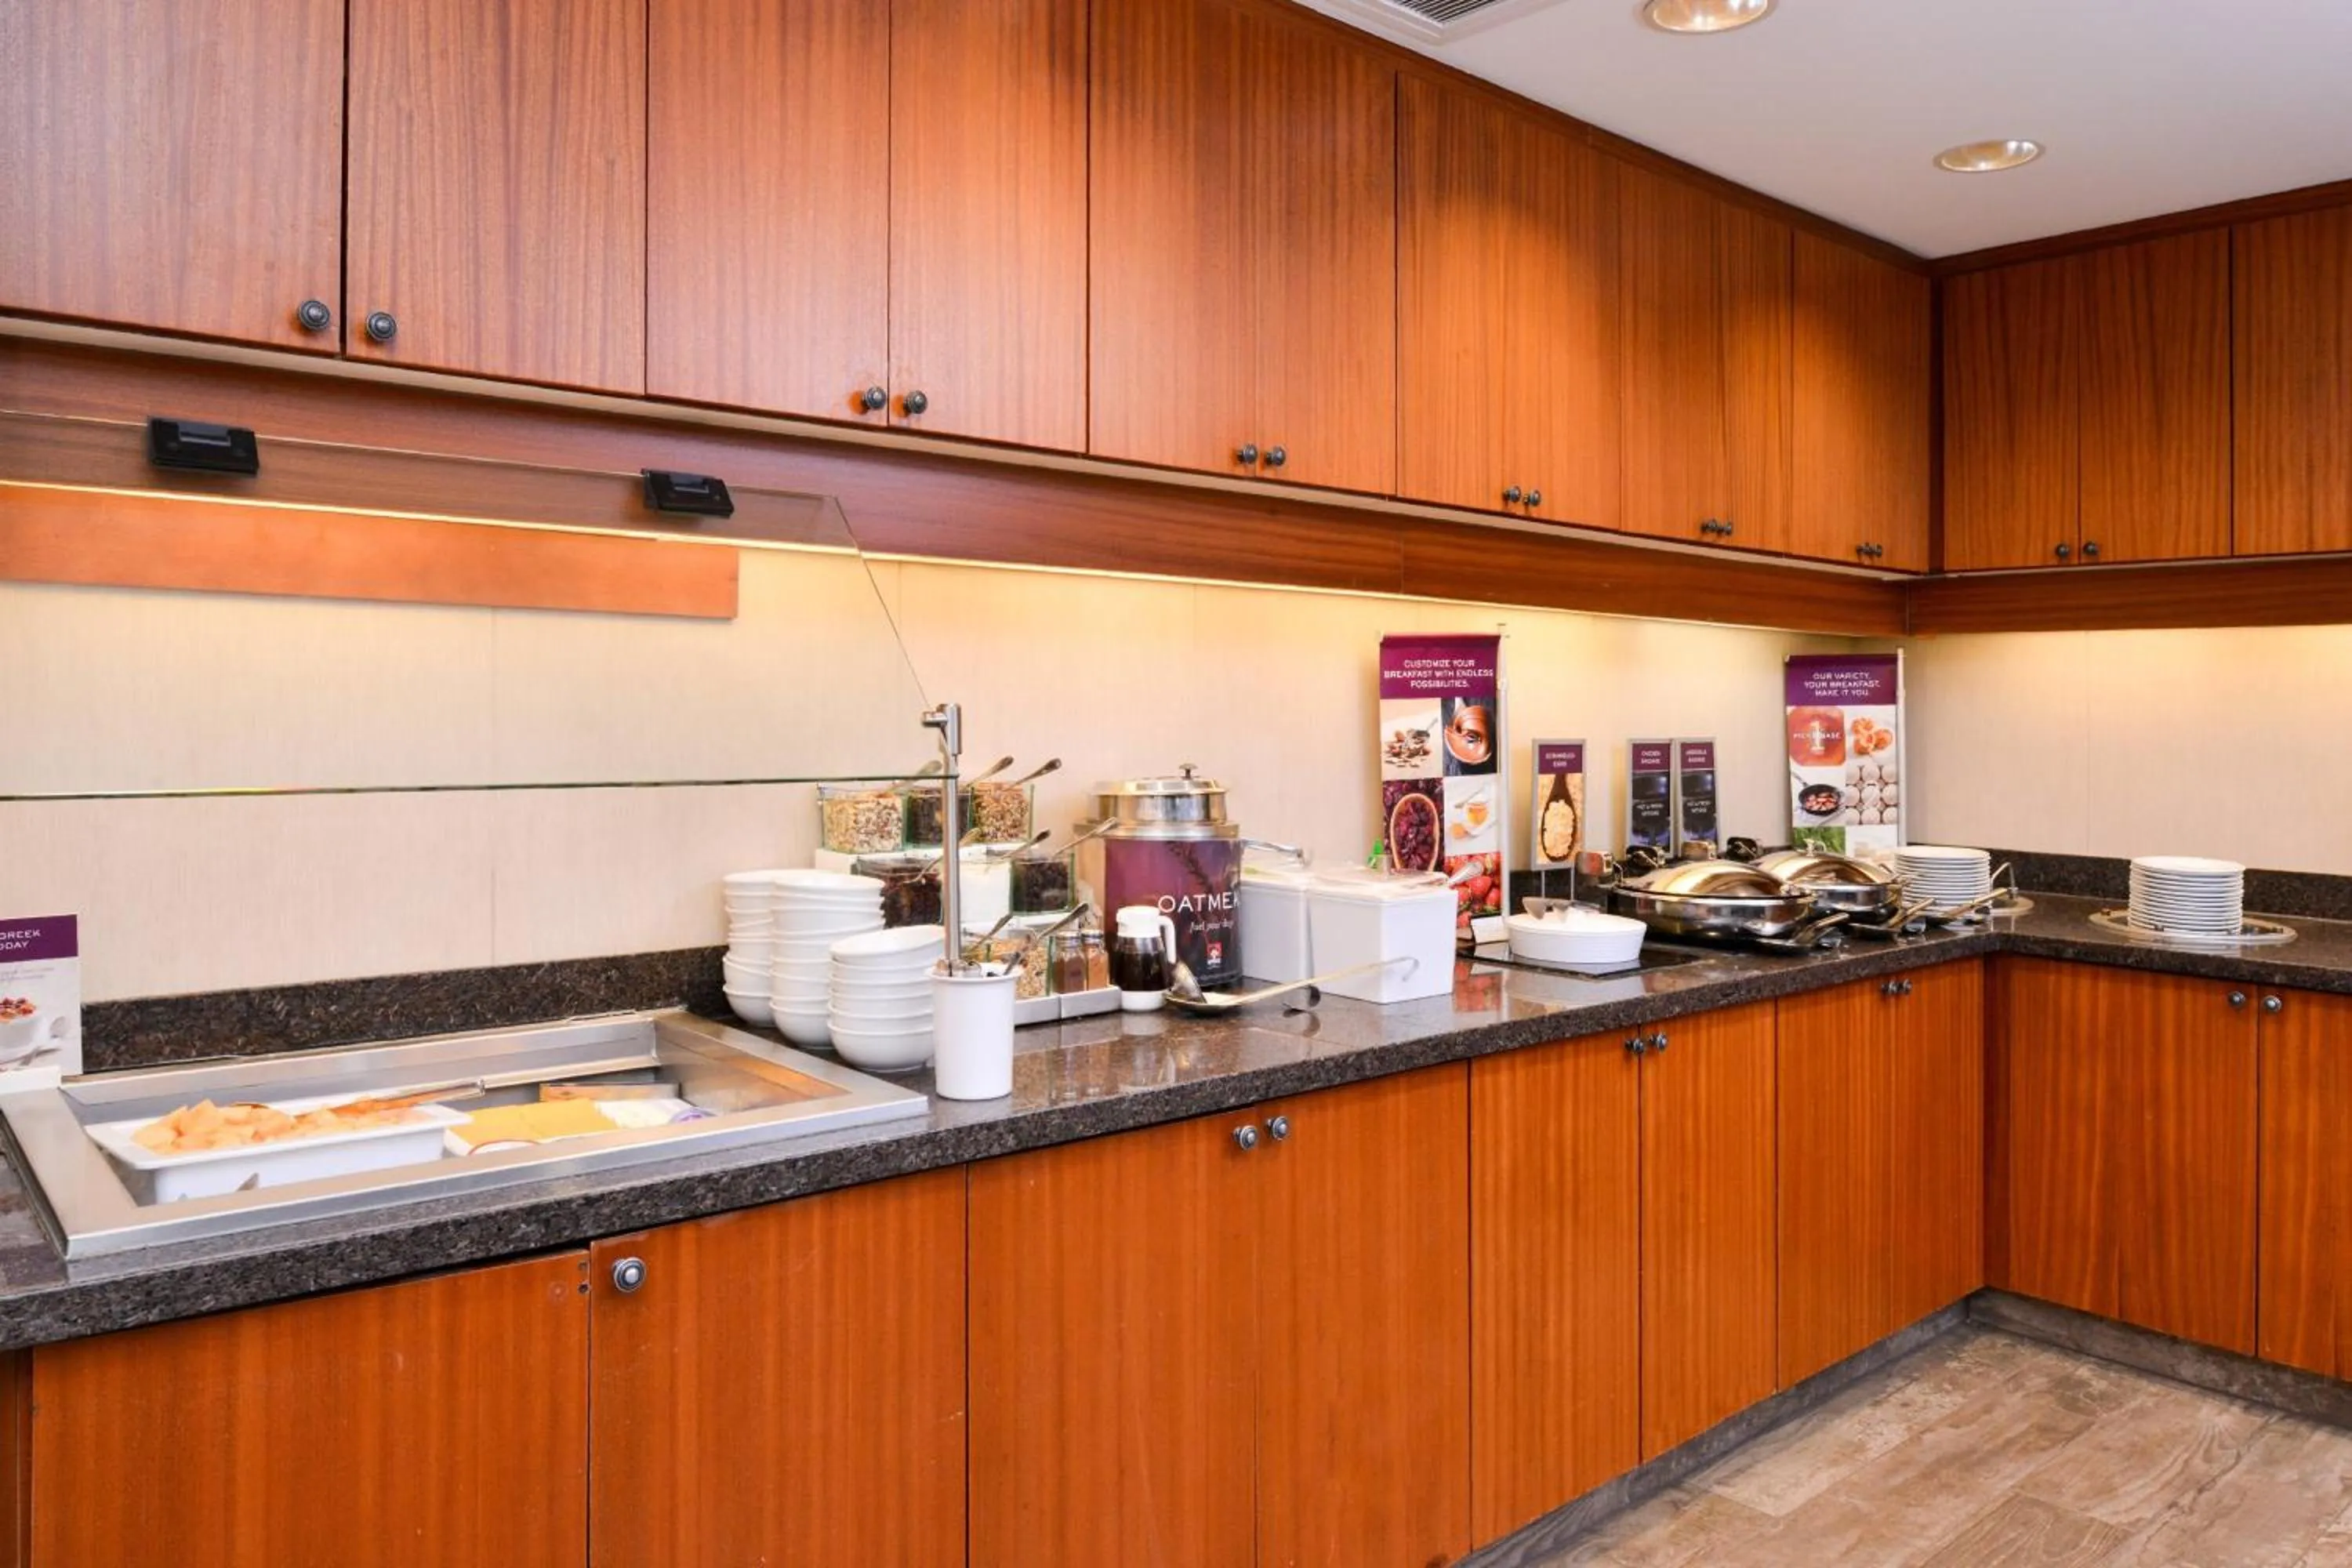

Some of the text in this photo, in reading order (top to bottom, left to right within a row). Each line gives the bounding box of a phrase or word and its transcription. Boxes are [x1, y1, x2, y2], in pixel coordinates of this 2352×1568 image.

[1404, 659, 1451, 668] CUSTOMIZE
[1456, 669, 1494, 677] ENDLESS
[0, 940, 30, 950] ODAY
